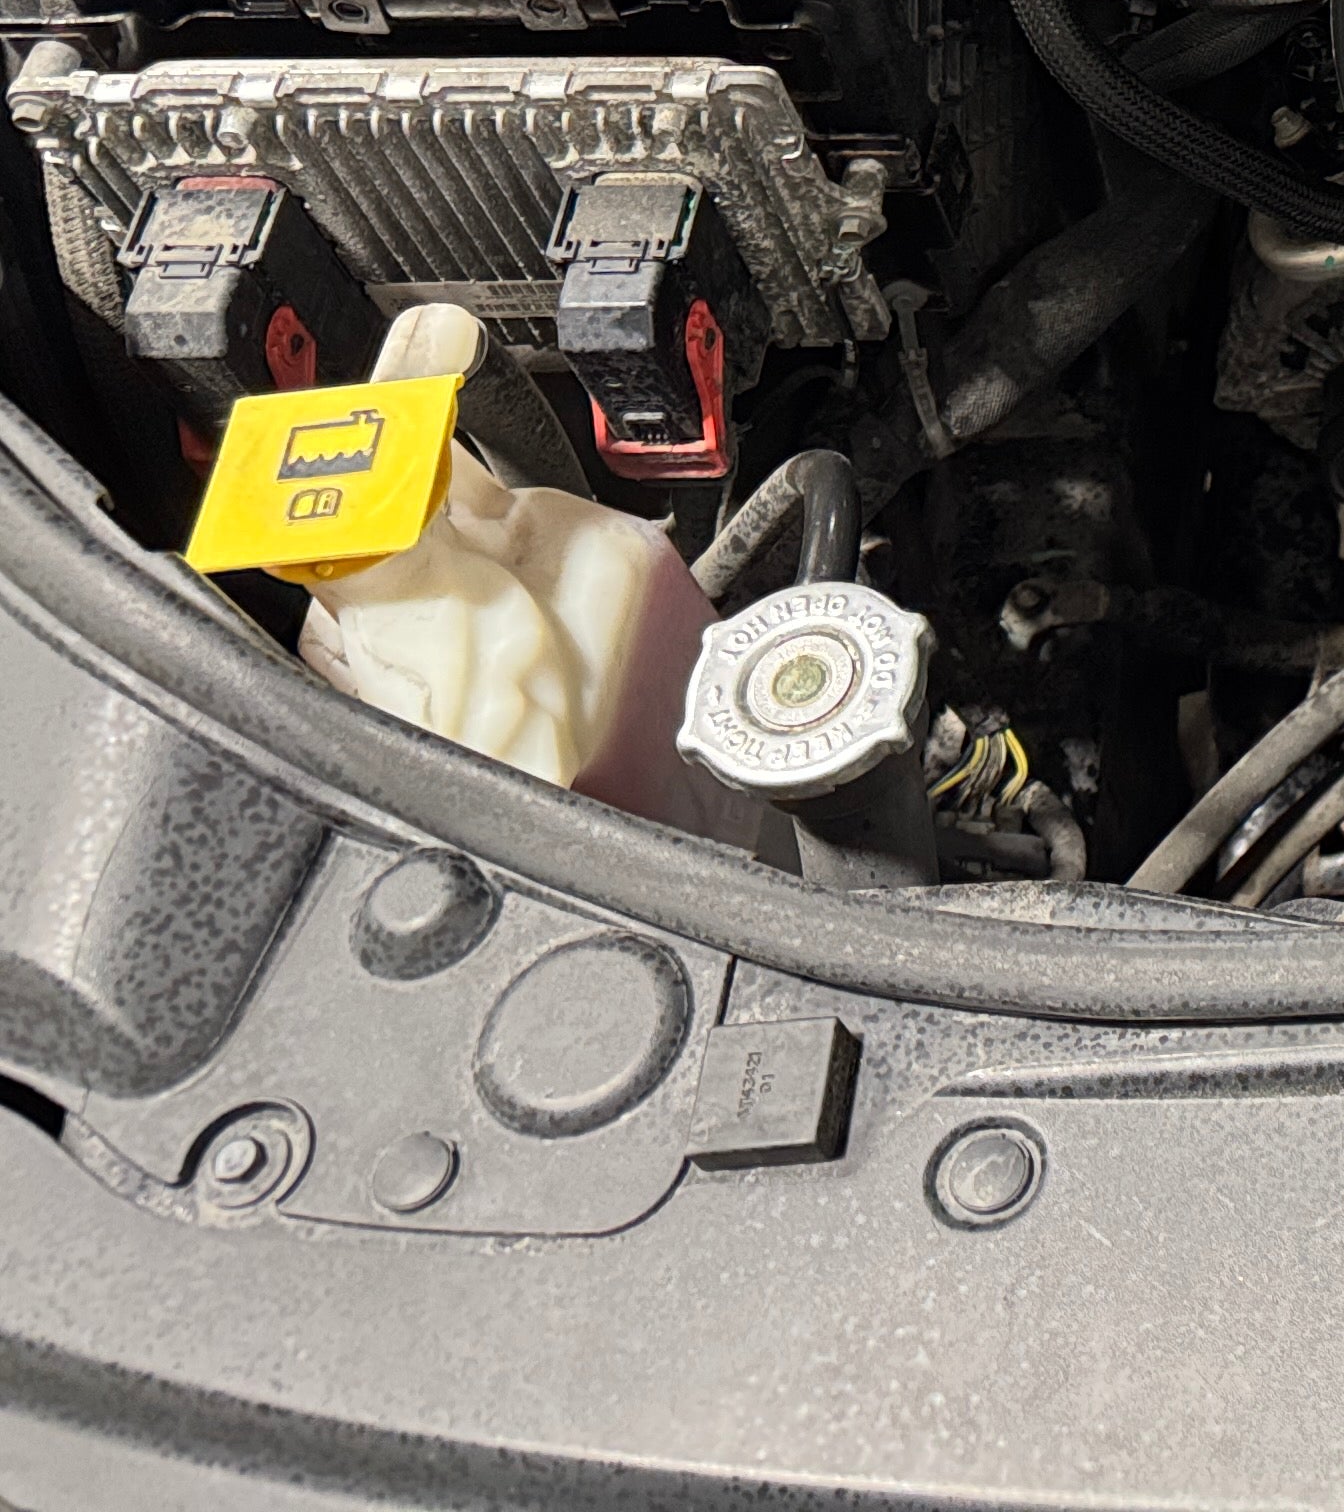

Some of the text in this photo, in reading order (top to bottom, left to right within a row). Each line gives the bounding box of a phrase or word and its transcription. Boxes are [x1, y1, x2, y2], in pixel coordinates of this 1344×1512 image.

[768, 593, 850, 624] OPEN
[848, 604, 896, 650] NOT
[717, 614, 770, 665] HOT
[870, 651, 900, 689] DO
[704, 708, 853, 767] KEEP TIGHT
